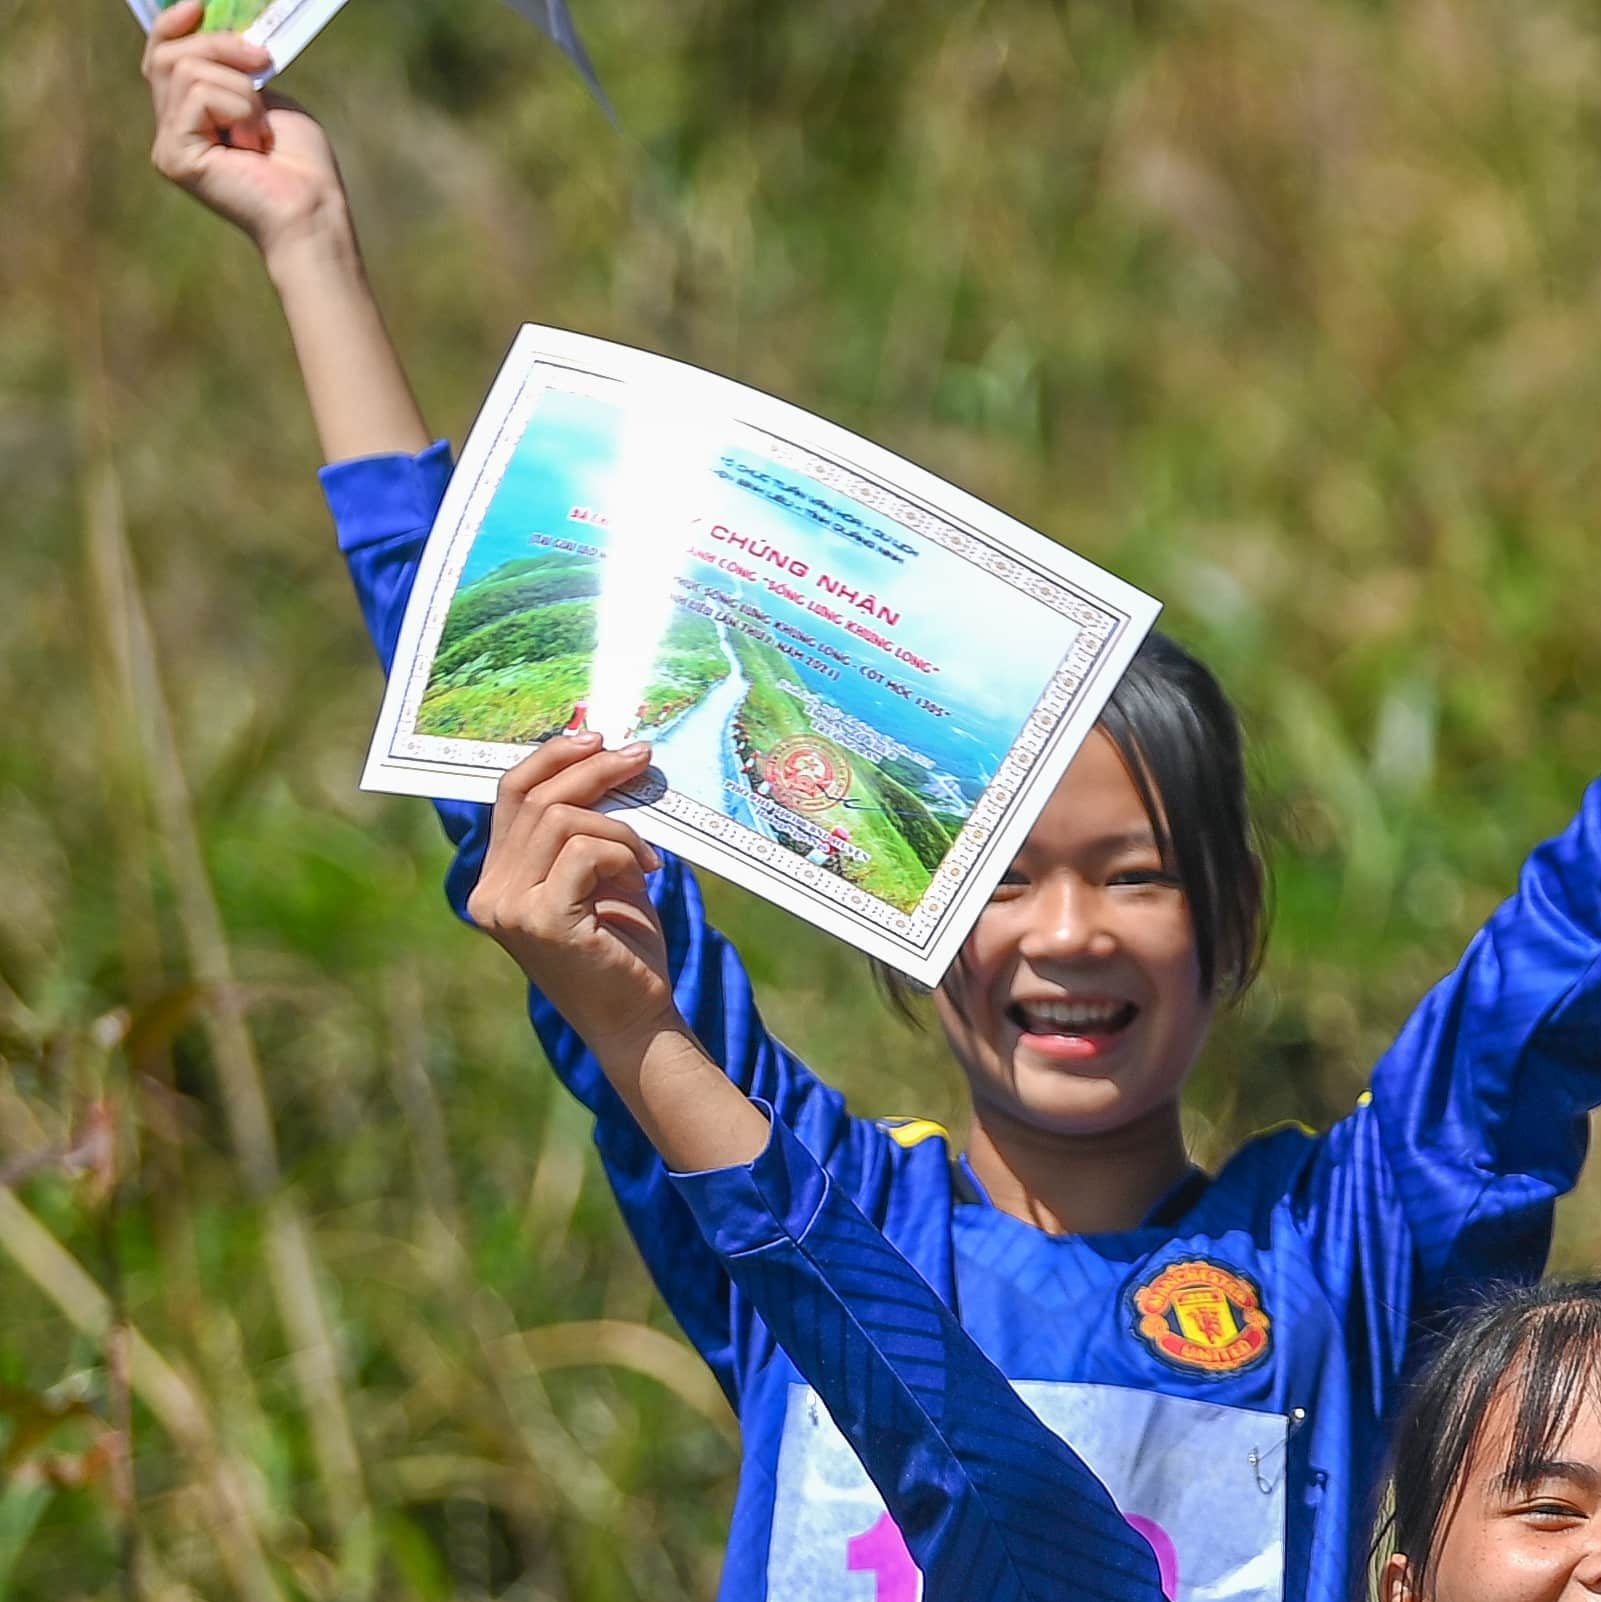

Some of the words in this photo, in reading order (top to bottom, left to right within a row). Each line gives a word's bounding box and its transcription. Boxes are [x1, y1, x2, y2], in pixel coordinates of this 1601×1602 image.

[710, 525, 809, 578] CHỨNG
[816, 574, 901, 627] NHẬN
[1181, 1339, 1252, 1363] UNITED
